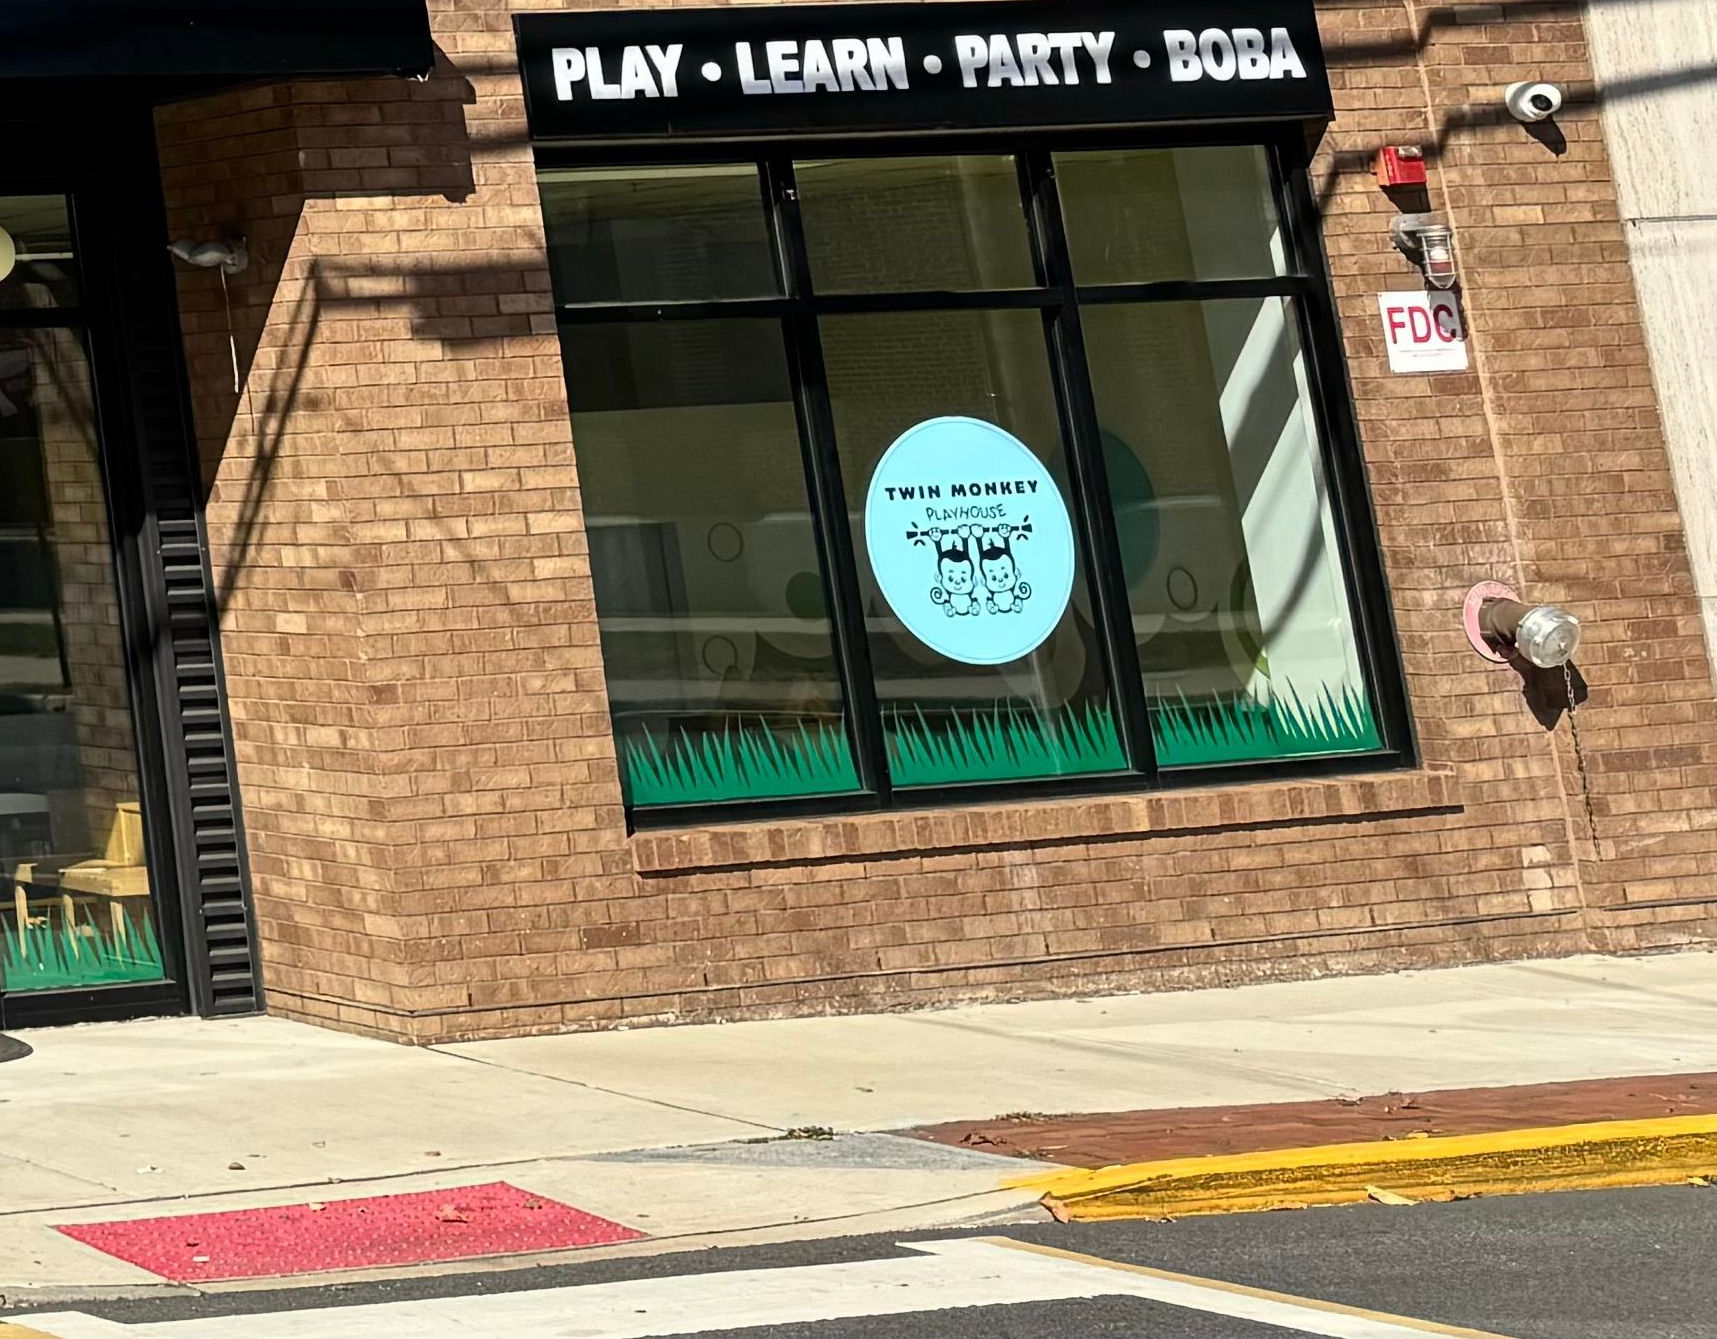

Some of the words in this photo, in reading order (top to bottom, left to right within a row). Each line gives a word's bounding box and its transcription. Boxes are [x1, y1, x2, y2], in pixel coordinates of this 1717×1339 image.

[550, 42, 684, 101] PLAY
[734, 34, 910, 95] LEARN
[954, 30, 1116, 88] PARTY
[1162, 26, 1307, 83] BOBA
[1386, 304, 1457, 344] FDC
[884, 484, 941, 501] TWIN
[951, 479, 1039, 498] MONKEY
[925, 503, 1007, 521] PLAYHOUSE
